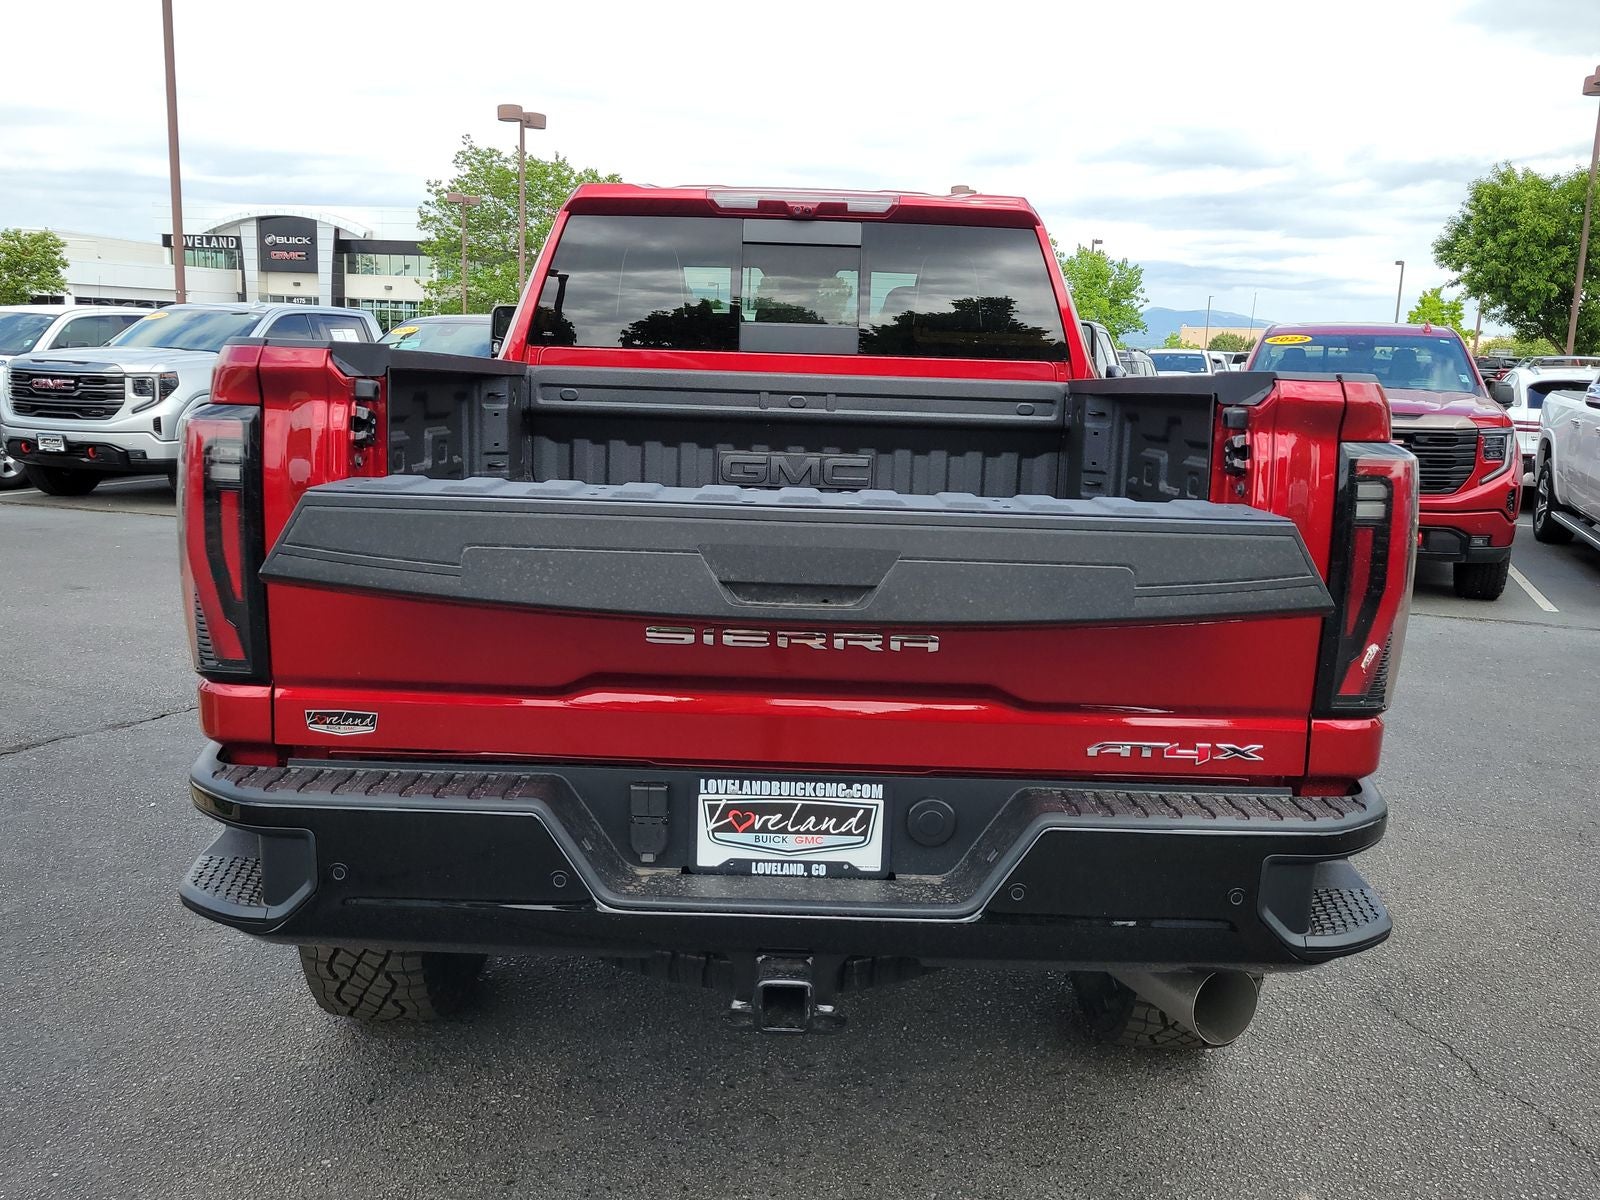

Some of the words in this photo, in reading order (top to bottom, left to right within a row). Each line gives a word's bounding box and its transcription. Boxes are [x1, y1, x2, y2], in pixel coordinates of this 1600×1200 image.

[276, 236, 311, 244] BUICK
[271, 251, 306, 260] GMC
[31, 378, 75, 390] GMC
[720, 454, 870, 486] GMC
[645, 625, 940, 653] SIERRA
[1087, 741, 1264, 765] AT4X
[700, 778, 883, 799] LOVELANDBUICKGMCCOM
[754, 834, 788, 844] BUICK
[794, 836, 824, 845] GMC
[751, 861, 808, 877] LOVELAND,
[811, 864, 827, 876] CO
